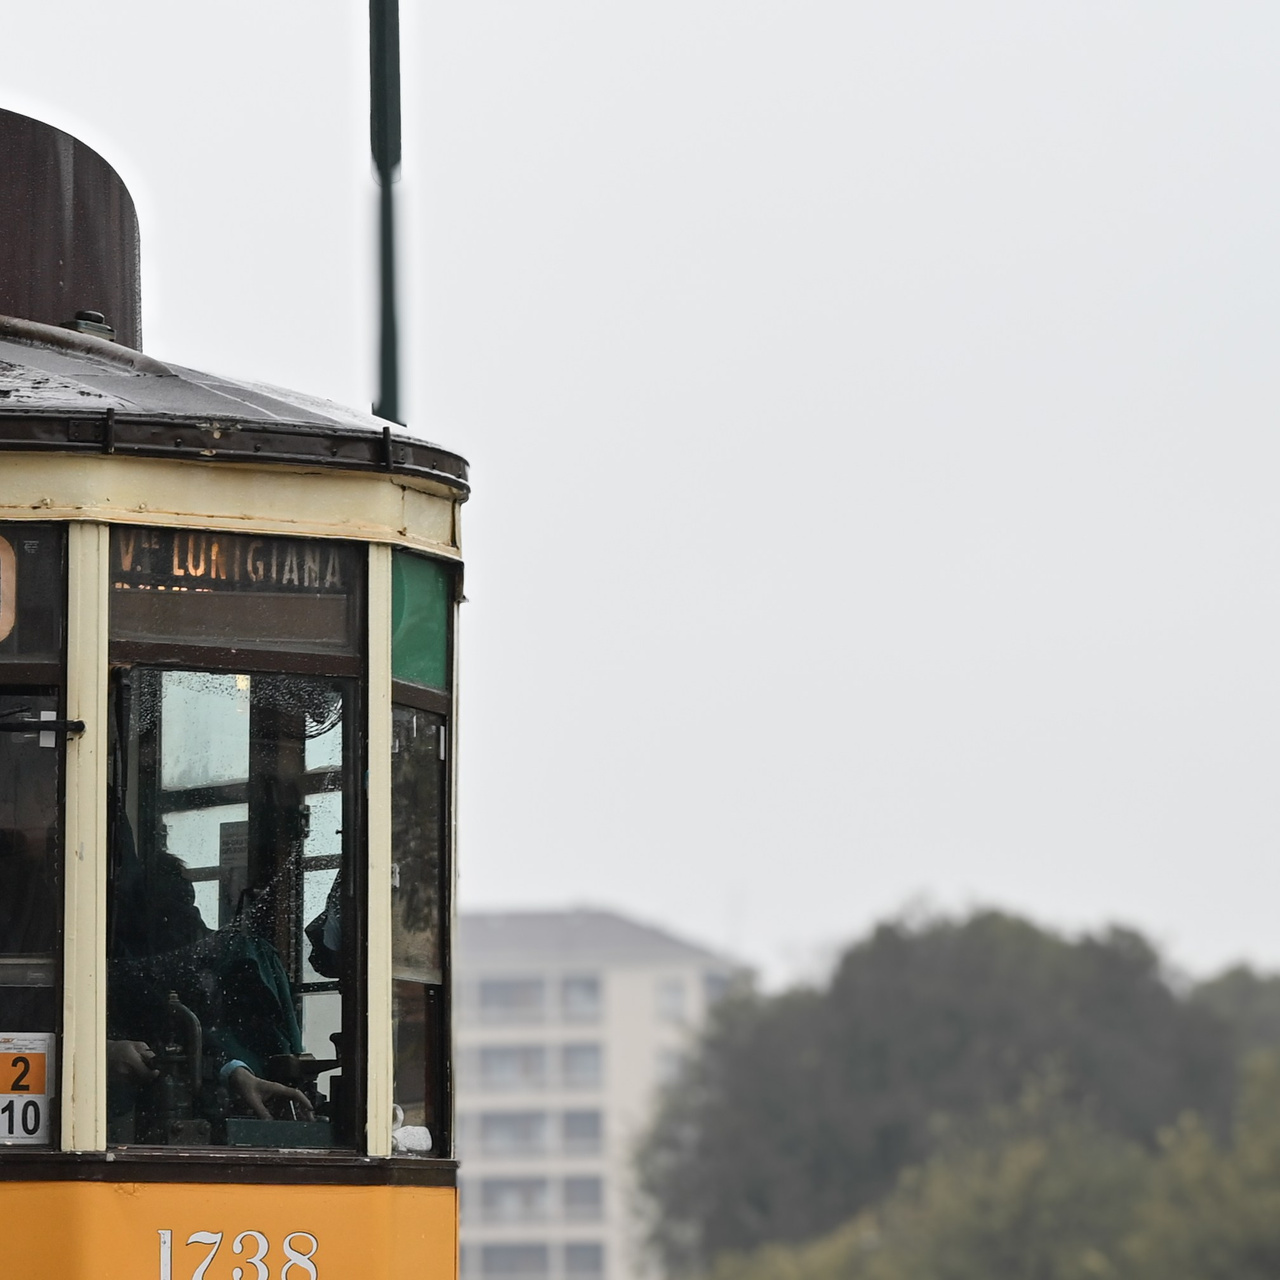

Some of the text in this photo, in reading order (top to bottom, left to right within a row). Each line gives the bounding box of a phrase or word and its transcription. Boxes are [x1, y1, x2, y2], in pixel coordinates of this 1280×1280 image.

[172, 533, 342, 588] LUNIGIANA
[10, 1056, 31, 1092] 2
[0, 1099, 41, 1136] 10
